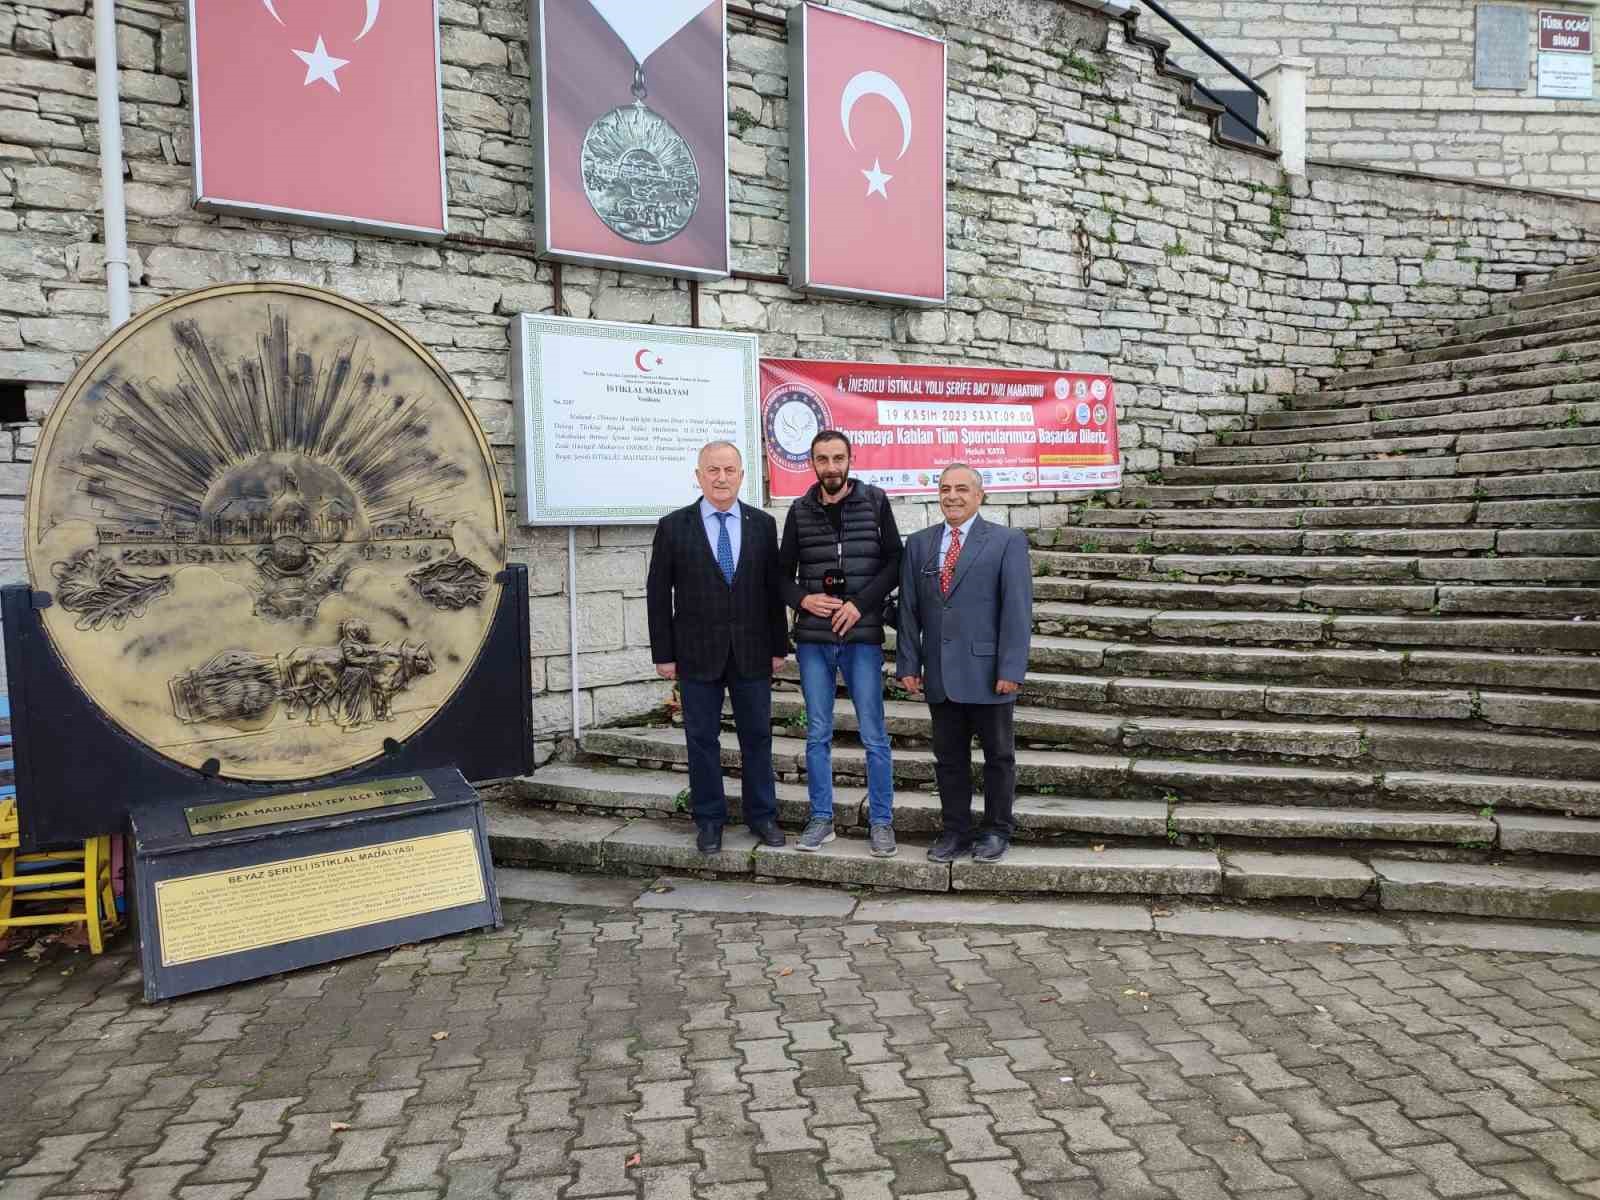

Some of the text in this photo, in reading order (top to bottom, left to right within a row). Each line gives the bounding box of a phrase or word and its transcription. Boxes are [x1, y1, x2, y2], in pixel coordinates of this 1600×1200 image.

[1542, 16, 1563, 30] TÜRK
[1552, 33, 1580, 48] BİNASI
[848, 375, 886, 393] İNEBOLU
[887, 376, 923, 394] İSTİKLAL
[925, 380, 943, 395] YOLU
[946, 379, 972, 397] ŞERİFE
[973, 382, 989, 396] BACI
[1007, 383, 1045, 398] MARATONU
[886, 408, 899, 421] 19
[903, 408, 938, 421] KASIM
[942, 409, 967, 422] 2023
[896, 426, 934, 444] Katılan
[935, 427, 959, 444] Tüm
[961, 427, 1037, 446] Sporcularımıza
[228, 871, 265, 884] BEYAZ
[358, 845, 415, 861] MADALYASI
